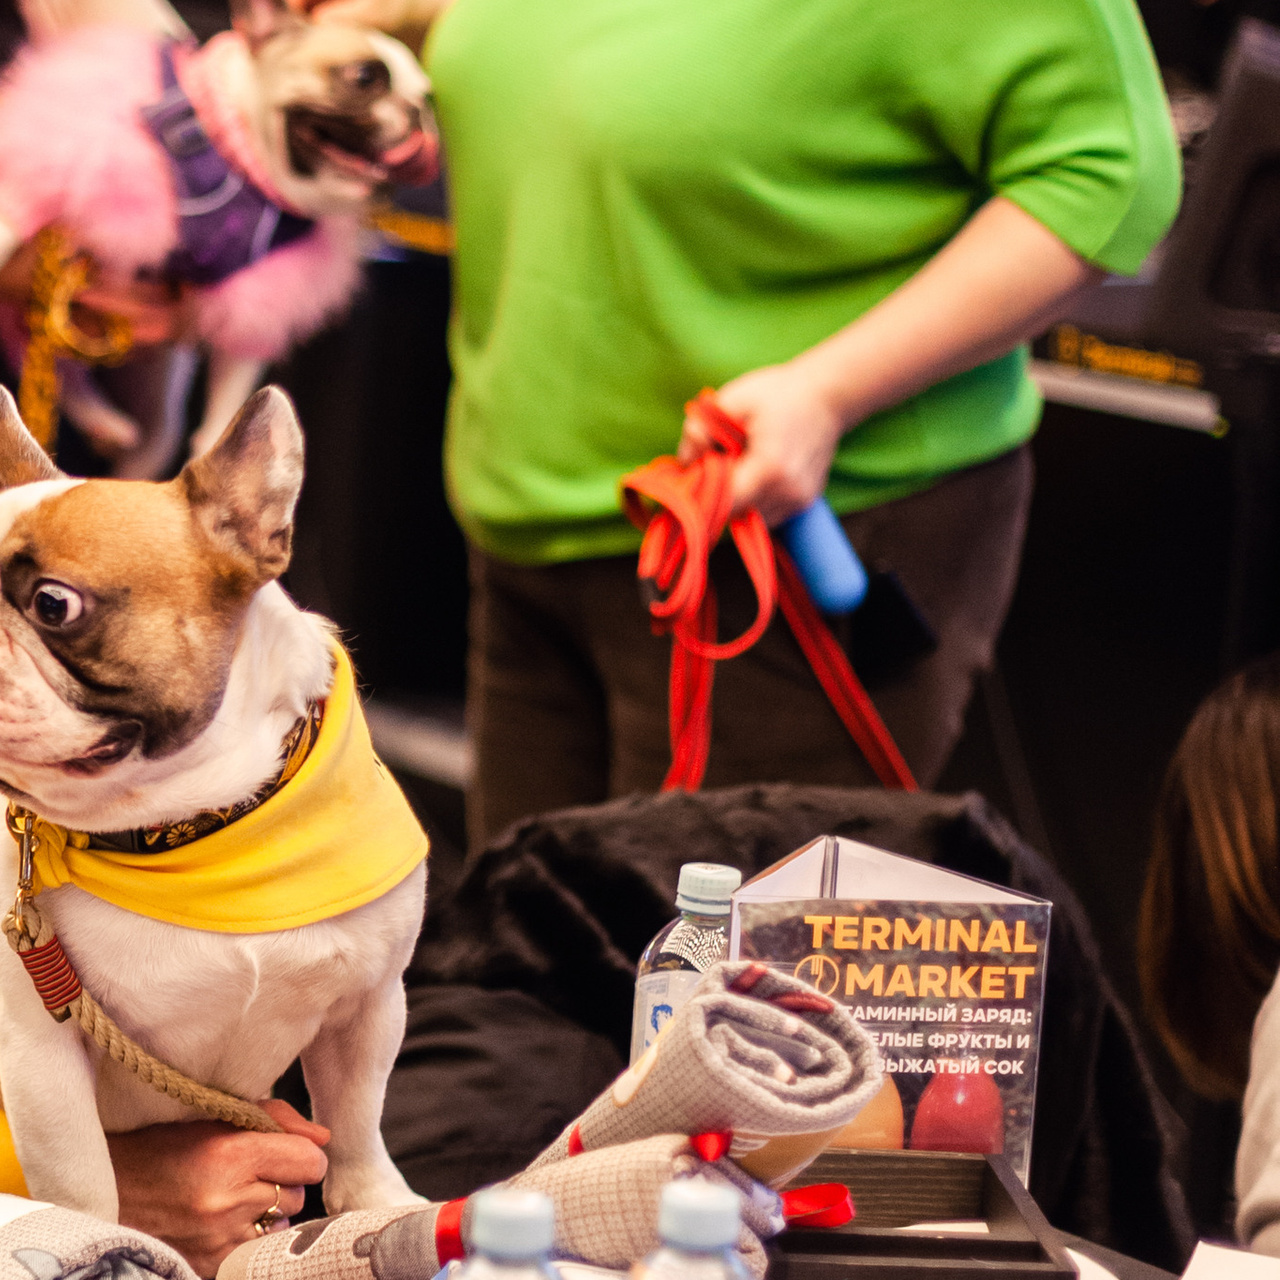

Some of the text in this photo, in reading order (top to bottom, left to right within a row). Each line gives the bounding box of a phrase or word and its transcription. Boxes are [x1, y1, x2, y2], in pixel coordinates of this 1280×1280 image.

[804, 914, 1038, 954] TERMINAL
[845, 962, 1035, 1000] MARKET
[846, 1004, 1033, 1026] ТАМИННЫЙ ЗАРЯД:
[873, 1031, 1030, 1049] ЕЛЫЕ ФРУКТЫ И
[876, 1055, 1025, 1075] ВЫЖАТЫЙ СОК
